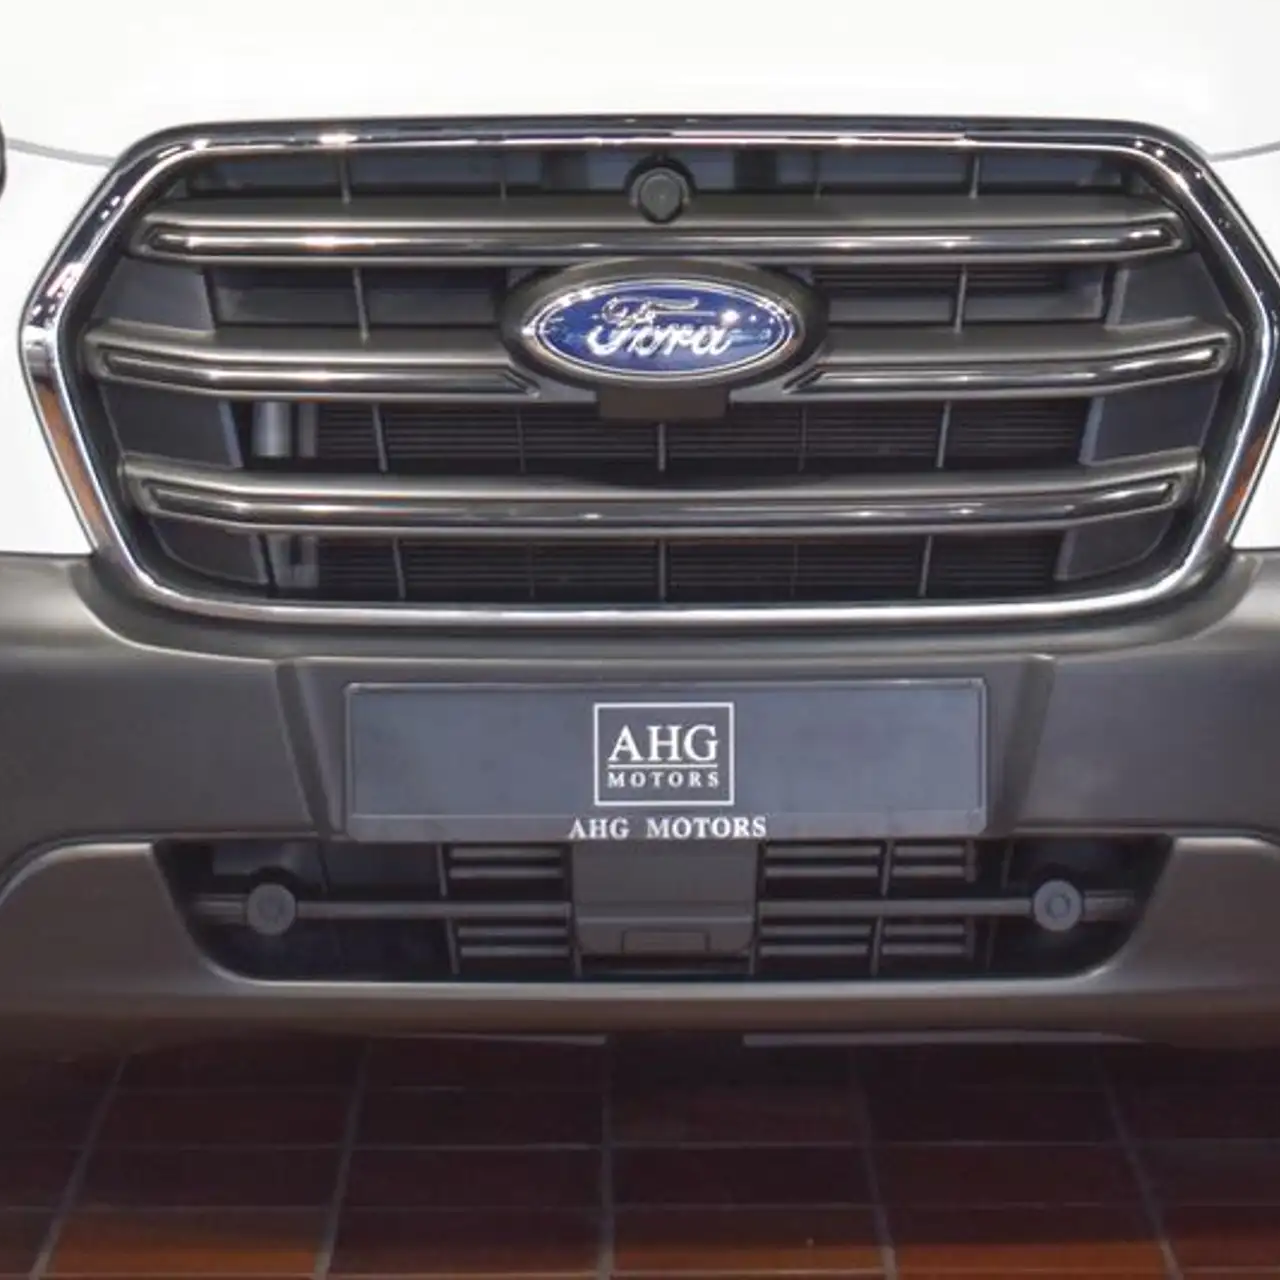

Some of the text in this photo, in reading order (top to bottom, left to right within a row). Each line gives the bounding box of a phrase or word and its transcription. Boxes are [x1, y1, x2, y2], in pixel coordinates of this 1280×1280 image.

[585, 296, 736, 357] Ford
[607, 724, 719, 762] AHG
[607, 771, 719, 788] MOTORS
[568, 815, 767, 839] AHG MOTORS
